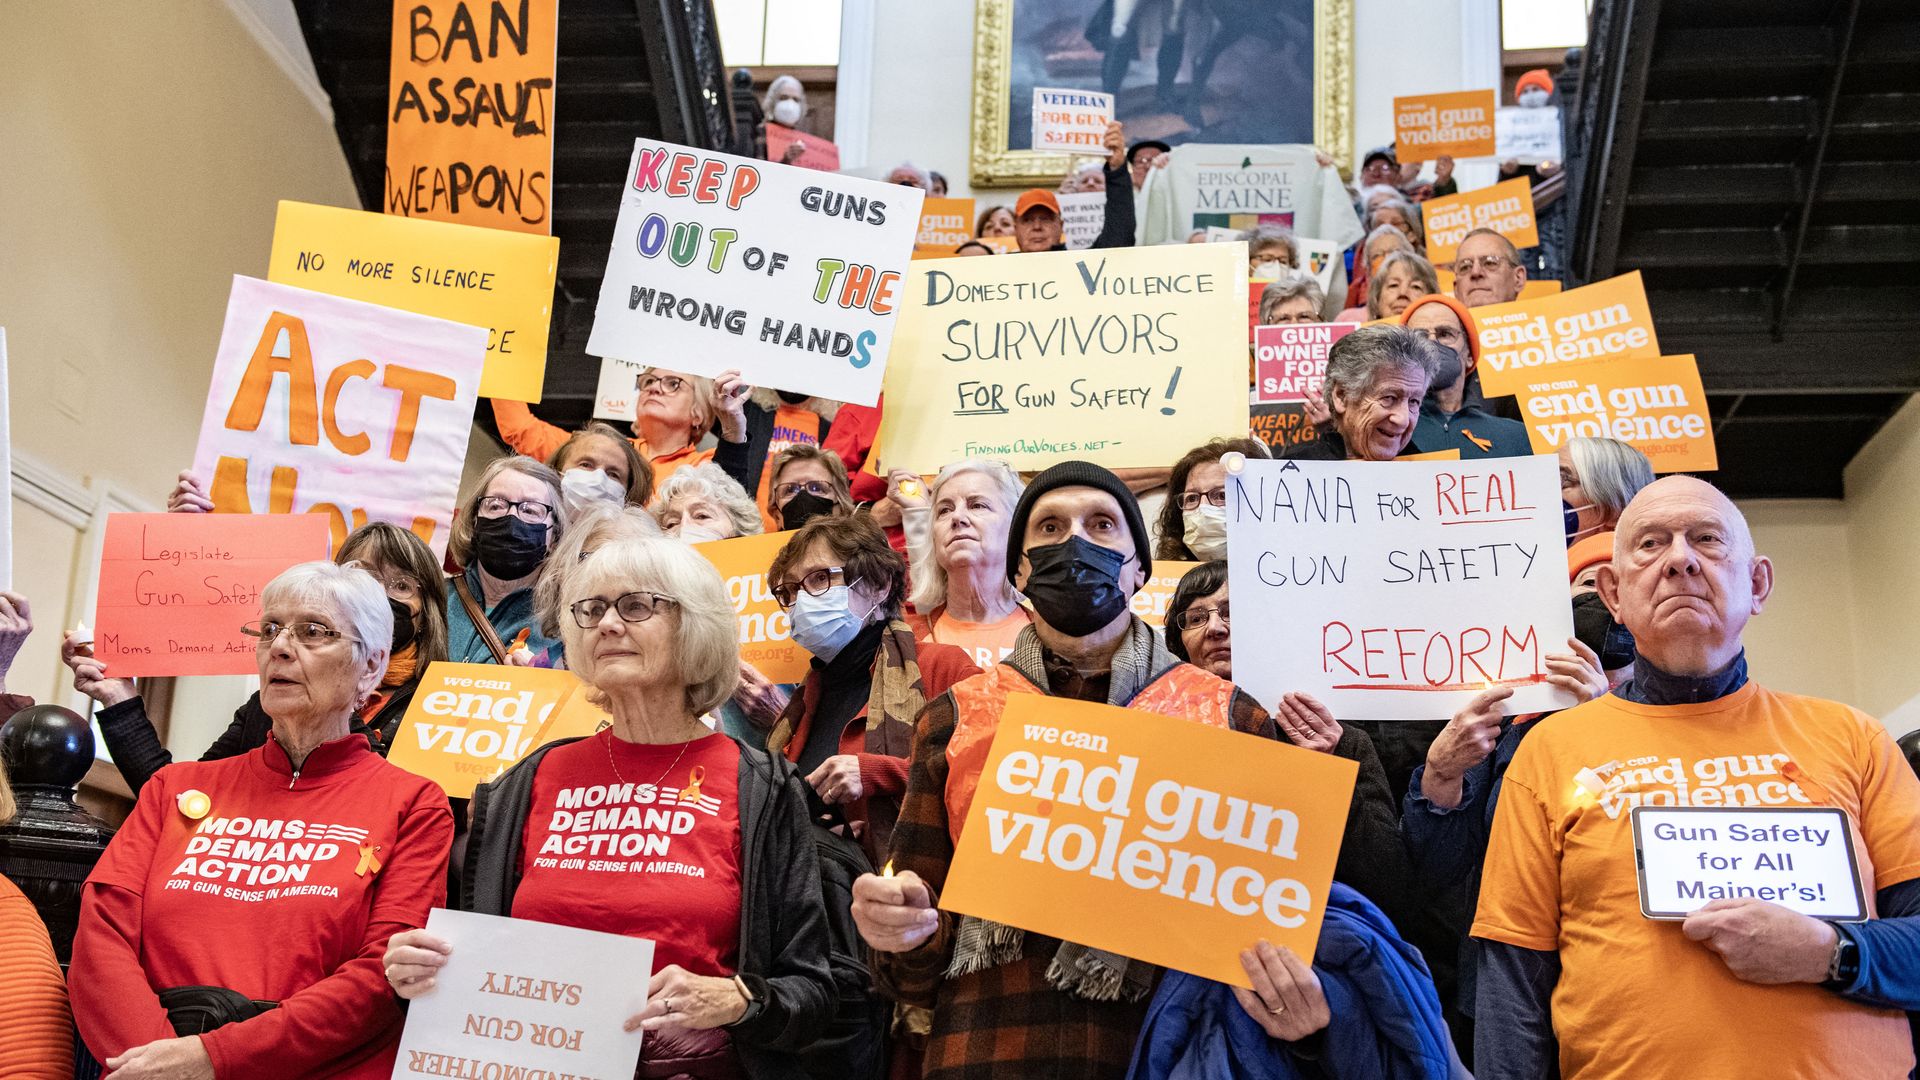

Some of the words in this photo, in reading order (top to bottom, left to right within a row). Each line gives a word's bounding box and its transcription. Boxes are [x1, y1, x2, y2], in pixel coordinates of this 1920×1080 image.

[410, 0, 529, 64] BAN
[393, 77, 552, 138] ASSAULT
[1043, 94, 1106, 108] VETERAN
[1042, 112, 1071, 125] FOR
[1077, 113, 1108, 127] GUN
[1398, 107, 1437, 128] end
[1440, 107, 1485, 125] gun
[1045, 131, 1101, 145] SAFETY
[1400, 124, 1492, 145] violence
[633, 147, 760, 211] KEEP
[800, 186, 888, 226] GUNS
[1197, 171, 1292, 186] EPISCOPAL
[386, 162, 545, 225] WEAPONS
[1196, 187, 1293, 209] MAINE
[921, 214, 964, 232] gun
[1428, 204, 1473, 230] end
[1474, 197, 1521, 220] gun
[917, 229, 970, 247] ence
[297, 251, 325, 272] NO
[347, 259, 394, 280] MORE
[411, 266, 496, 291] SILENCE
[637, 212, 737, 274] OUT
[743, 246, 789, 277] OF
[813, 258, 901, 316] THE
[923, 270, 1059, 307] DOMESTIC
[1076, 257, 1214, 296] VIOLENCE
[628, 285, 747, 336] WRONG
[760, 317, 877, 369] HANDS
[1479, 316, 1552, 349] end
[1555, 303, 1632, 343] gun
[1481, 314, 1502, 326] we
[1503, 312, 1528, 324] can
[942, 312, 1179, 362] SURVIVORS
[1281, 327, 1332, 344] GUN
[1484, 326, 1648, 372] violence
[224, 311, 457, 463] ACT
[956, 381, 1009, 412] FOR
[1015, 384, 1056, 408] GUN
[1528, 382, 1551, 393] we
[1552, 379, 1579, 391] can
[1528, 384, 1606, 418] end
[1608, 383, 1689, 417] gun
[1377, 493, 1420, 521] FOR
[1435, 470, 1537, 516] REAL
[142, 524, 234, 567] Legislate
[1257, 551, 1347, 587] GUN
[1383, 543, 1538, 583] SAFETY
[135, 570, 185, 606] Gun
[204, 575, 261, 614] Safet
[103, 633, 151, 655] Moms
[168, 639, 214, 653] Demand
[1322, 621, 1541, 687] REFORM
[443, 676, 472, 688] we
[474, 678, 511, 691] can
[422, 690, 536, 725] end
[1023, 724, 1058, 744] we
[1060, 730, 1108, 752] can
[1627, 756, 1659, 767] can
[1693, 753, 1792, 787] gun
[555, 783, 658, 809] MOMS
[996, 750, 1139, 817] end
[1142, 779, 1299, 860] gun
[196, 817, 306, 840] MOMS
[548, 807, 696, 835] DEMAND
[1653, 823, 1718, 841] Gun
[1728, 823, 1830, 846] Safety
[185, 837, 340, 862] DEMAND
[539, 834, 671, 857] ACTION
[172, 857, 312, 886] ACTION
[533, 857, 557, 868] FOR
[560, 858, 586, 870] GUN
[587, 860, 627, 872] SENSE
[629, 861, 643, 873] IN
[646, 861, 705, 878] AMERICA
[985, 807, 1312, 929] violence
[1697, 852, 1743, 871] for
[1754, 852, 1793, 871] All
[165, 879, 190, 890] FOR
[192, 881, 221, 895] GUN
[223, 887, 265, 902] SENSE
[265, 889, 280, 900] IN
[281, 885, 339, 897] AMERICA
[1676, 880, 1826, 902] Mainer's!
[478, 971, 582, 1006] SAFETY
[462, 1013, 524, 1042] GUN
[530, 1023, 585, 1051] FOR
